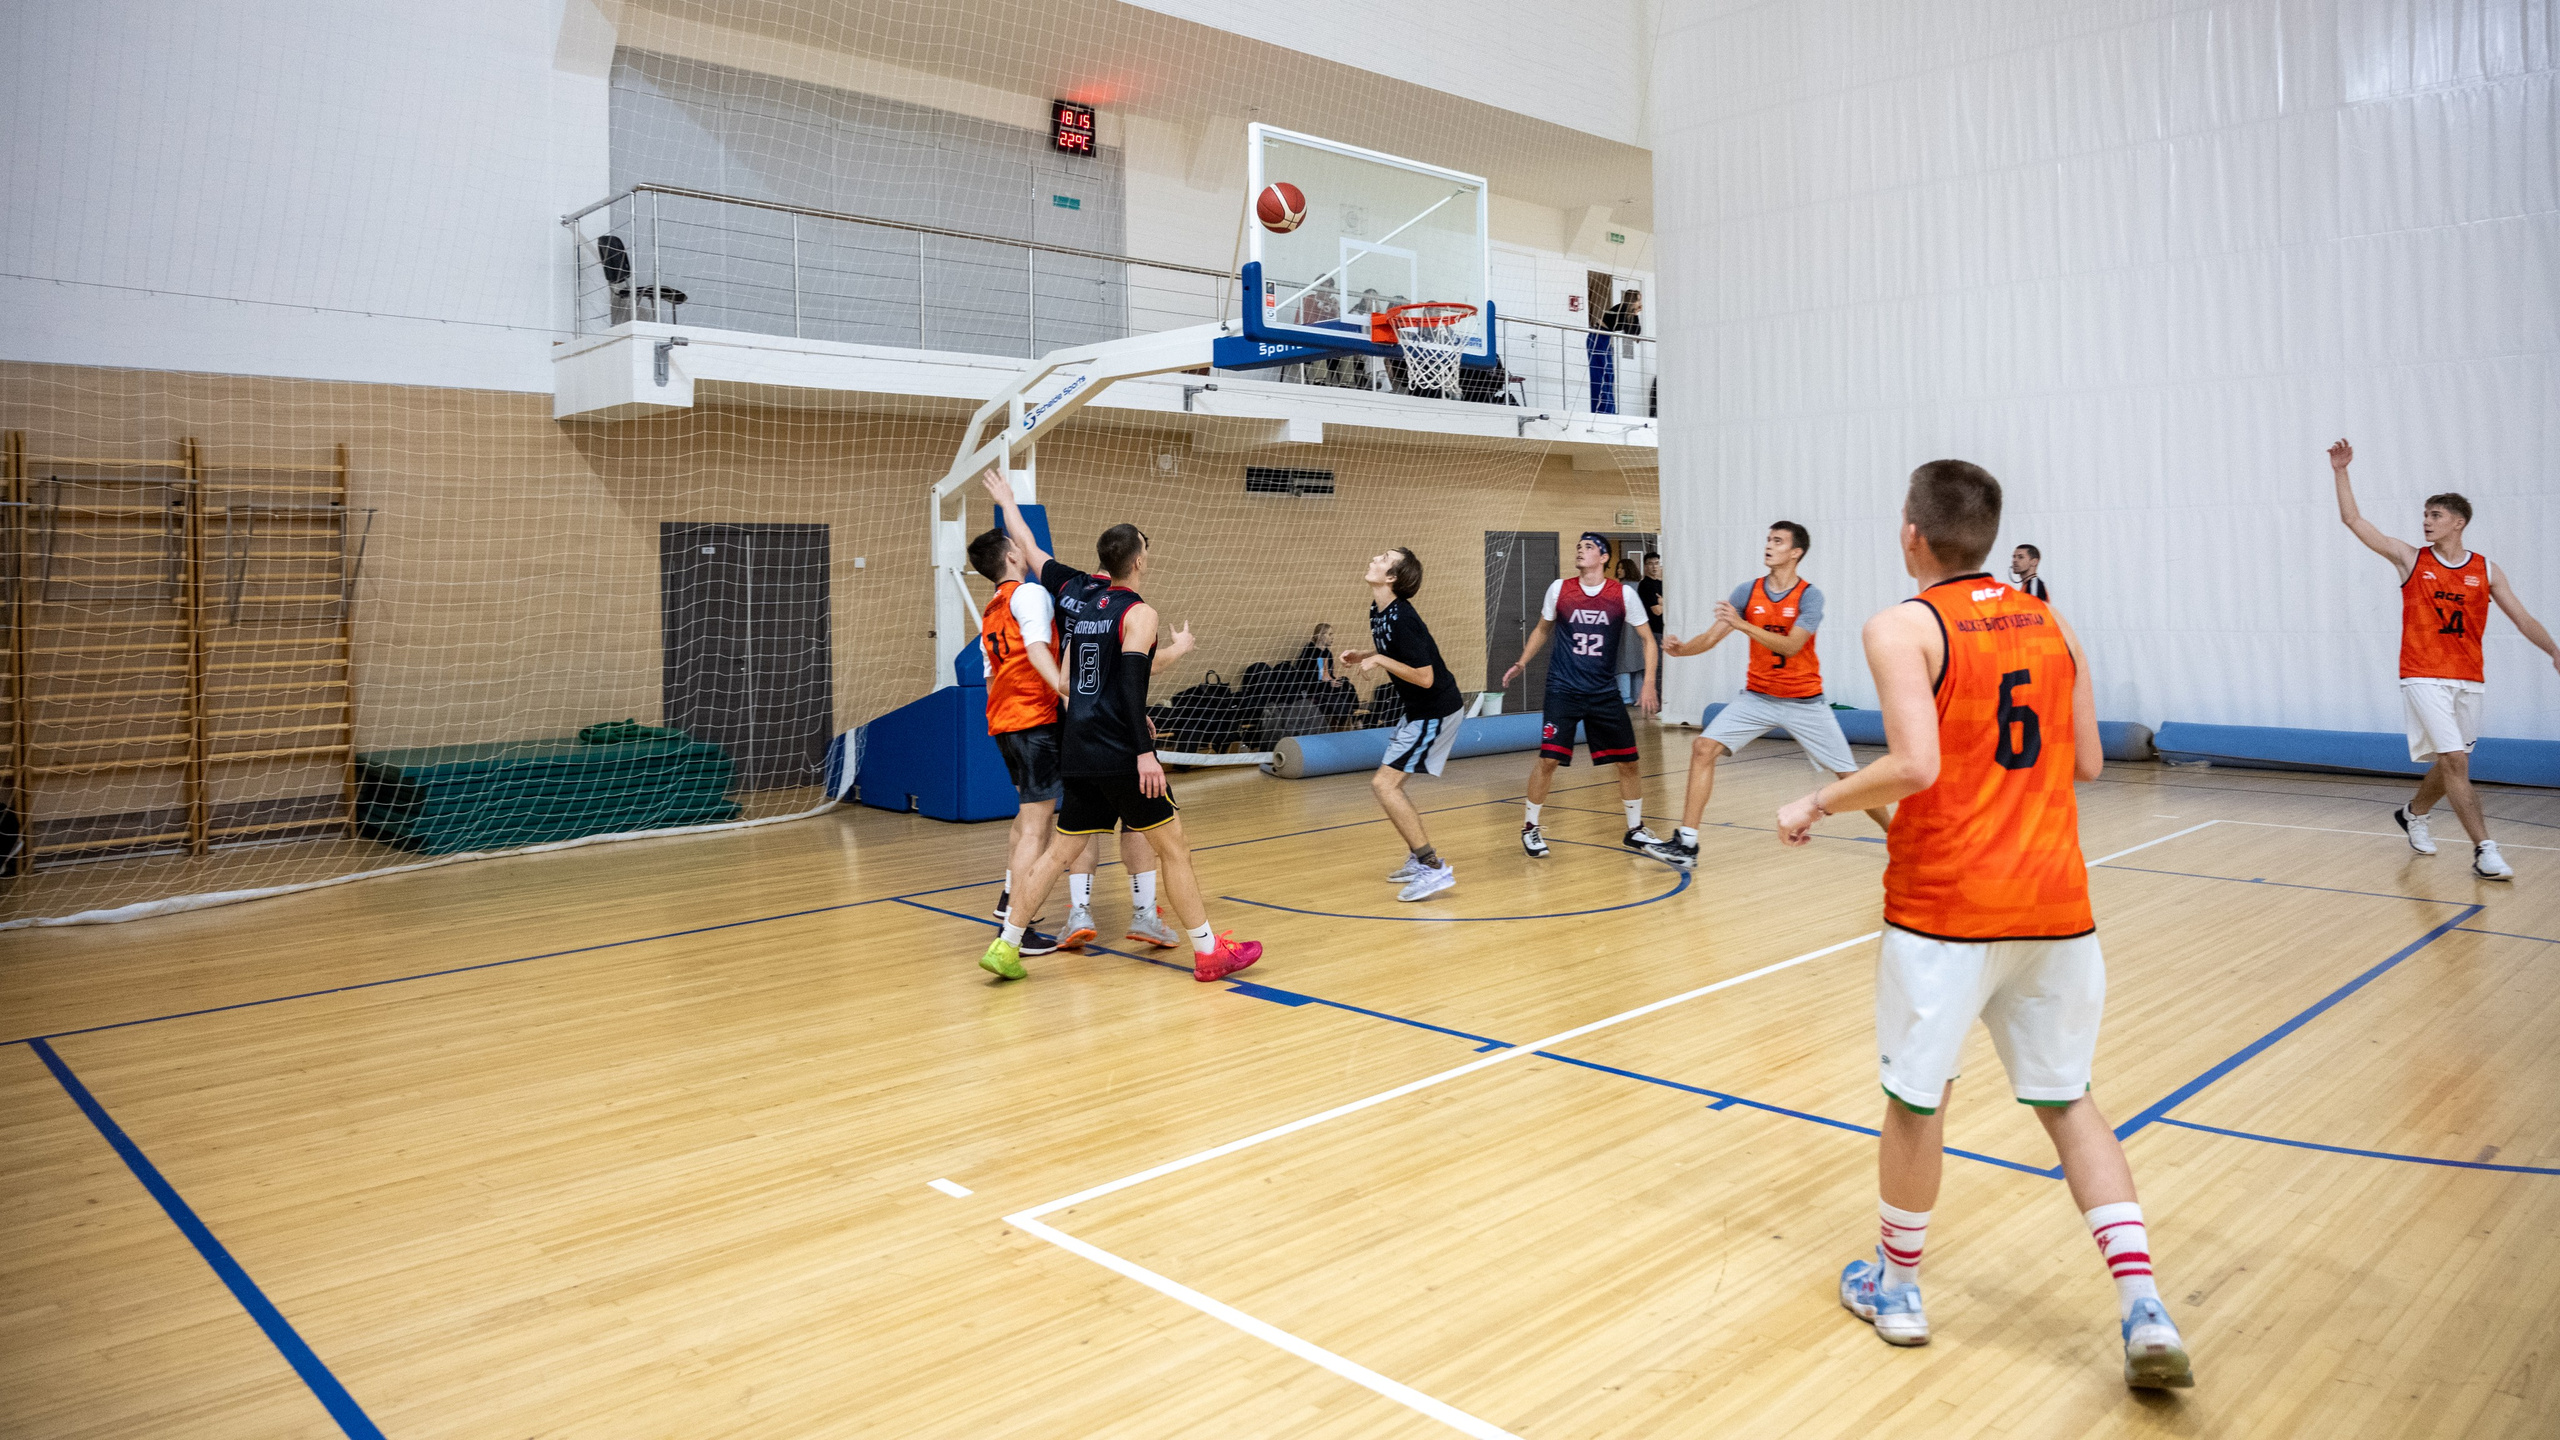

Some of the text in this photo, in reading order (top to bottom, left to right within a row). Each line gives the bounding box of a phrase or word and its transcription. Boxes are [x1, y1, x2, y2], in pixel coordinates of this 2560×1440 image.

[1059, 595, 1087, 613] KALE
[1572, 632, 1605, 657] 32
[1077, 642, 1100, 695] 8
[1995, 669, 2042, 770] 6
